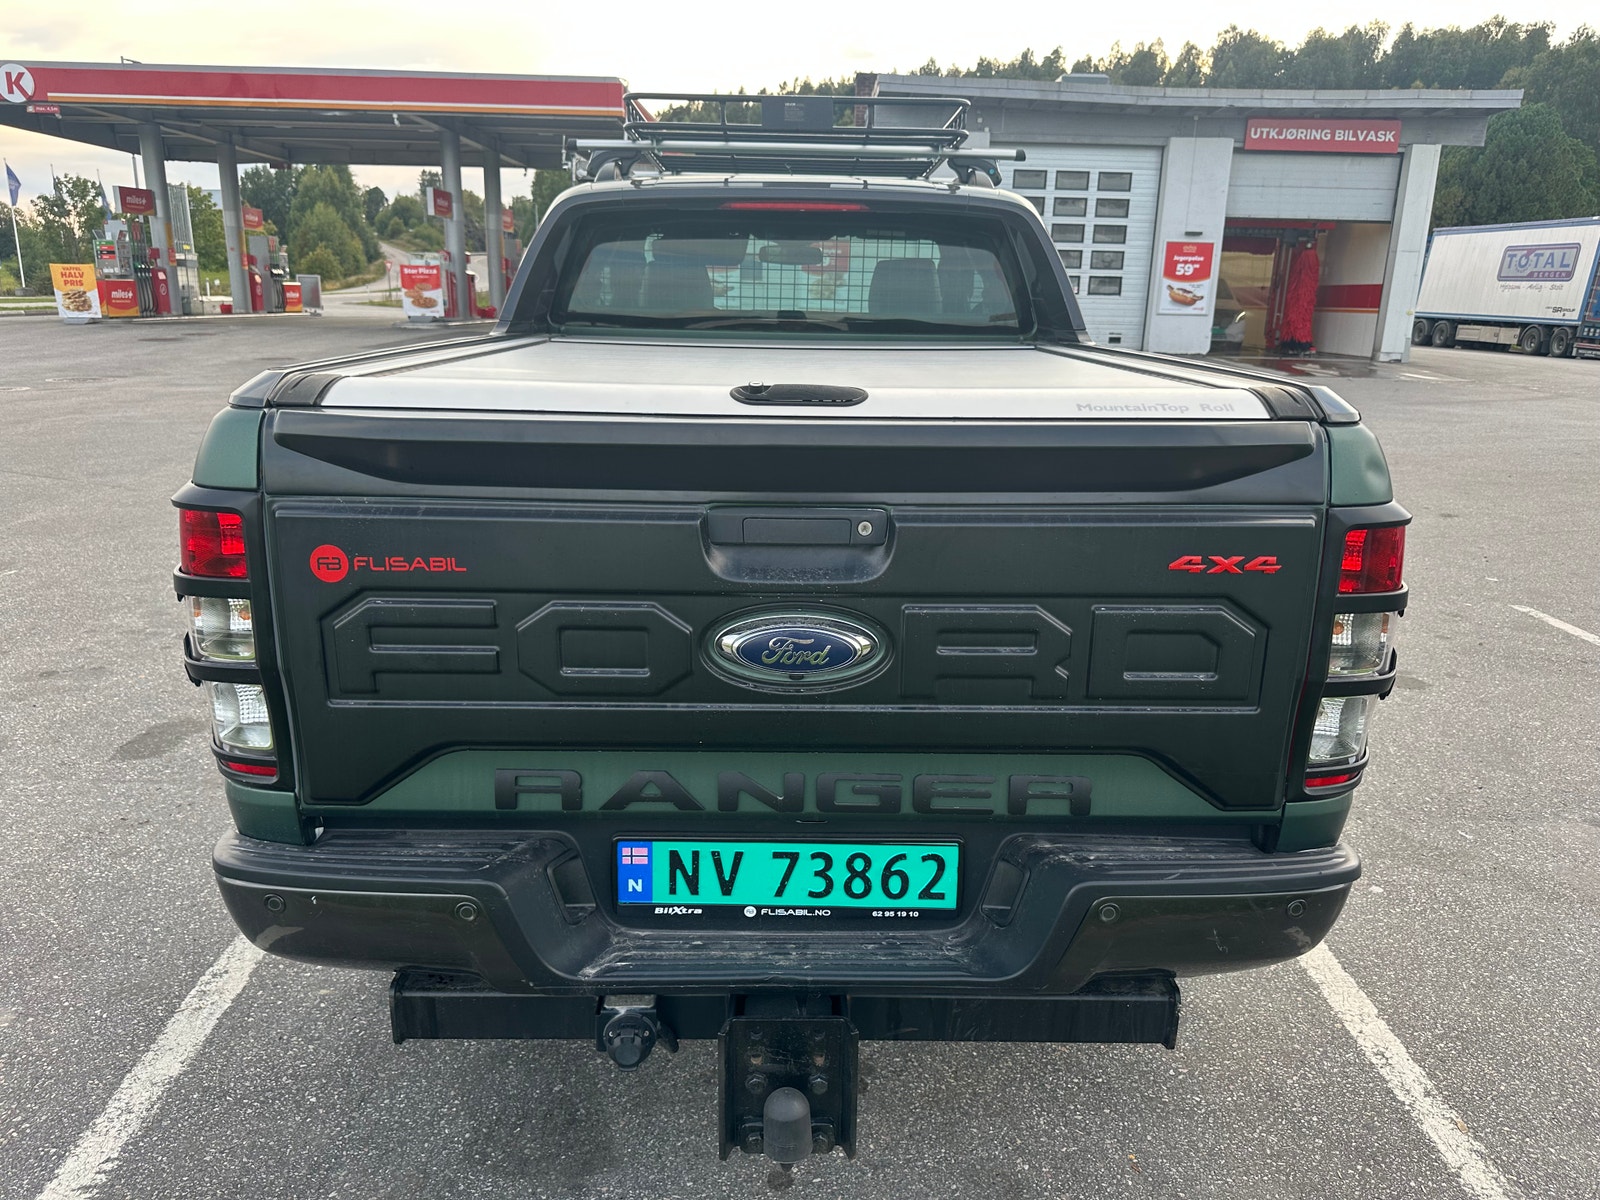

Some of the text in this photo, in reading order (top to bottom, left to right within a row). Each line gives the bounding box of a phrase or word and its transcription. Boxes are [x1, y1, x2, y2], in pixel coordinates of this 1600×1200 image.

[5, 71, 32, 100] K
[1250, 127, 1396, 142] UTKJØRING BILVASK
[1507, 251, 1571, 269] TOTAL
[60, 271, 84, 279] HALV
[63, 279, 84, 287] PRIS
[111, 289, 133, 299] miles+
[1075, 403, 1235, 414] MountainTop Roll
[353, 556, 467, 572] FLISABIL
[331, 598, 1262, 702] FORD
[761, 636, 831, 666] Ford
[494, 768, 1093, 817] RANGER
[668, 849, 947, 901] NV 73862
[627, 878, 643, 893] N
[760, 908, 831, 917] FLISABIL.NO
